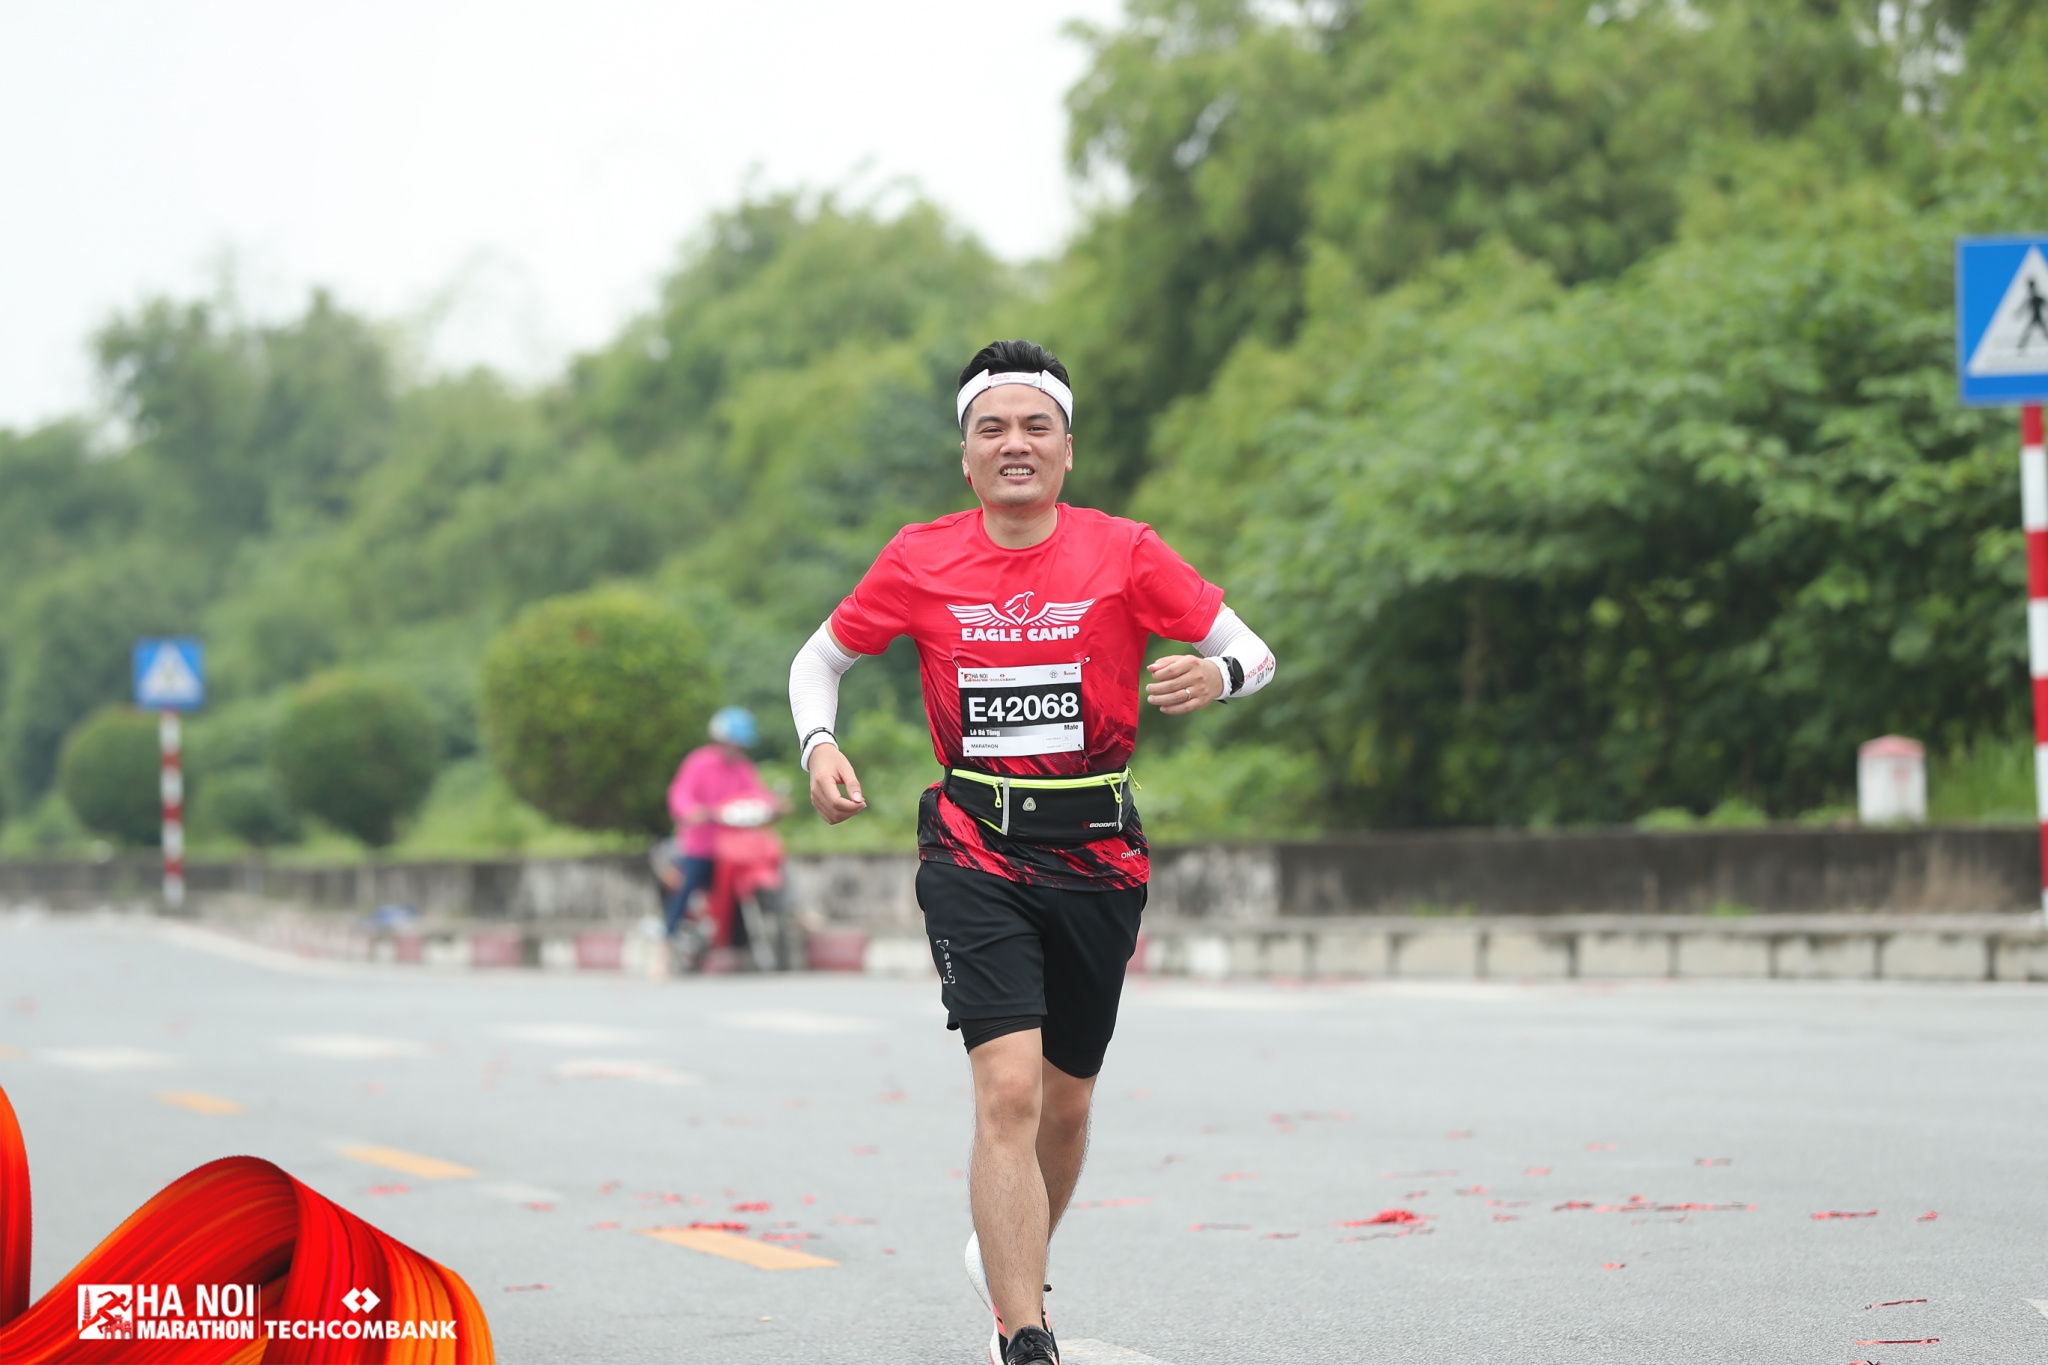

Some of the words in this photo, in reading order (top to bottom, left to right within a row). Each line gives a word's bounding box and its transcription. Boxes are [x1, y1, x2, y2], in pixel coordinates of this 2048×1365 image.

[961, 628, 1023, 642] EAGLE
[1026, 625, 1080, 642] CAMP
[968, 692, 1079, 722] E42068
